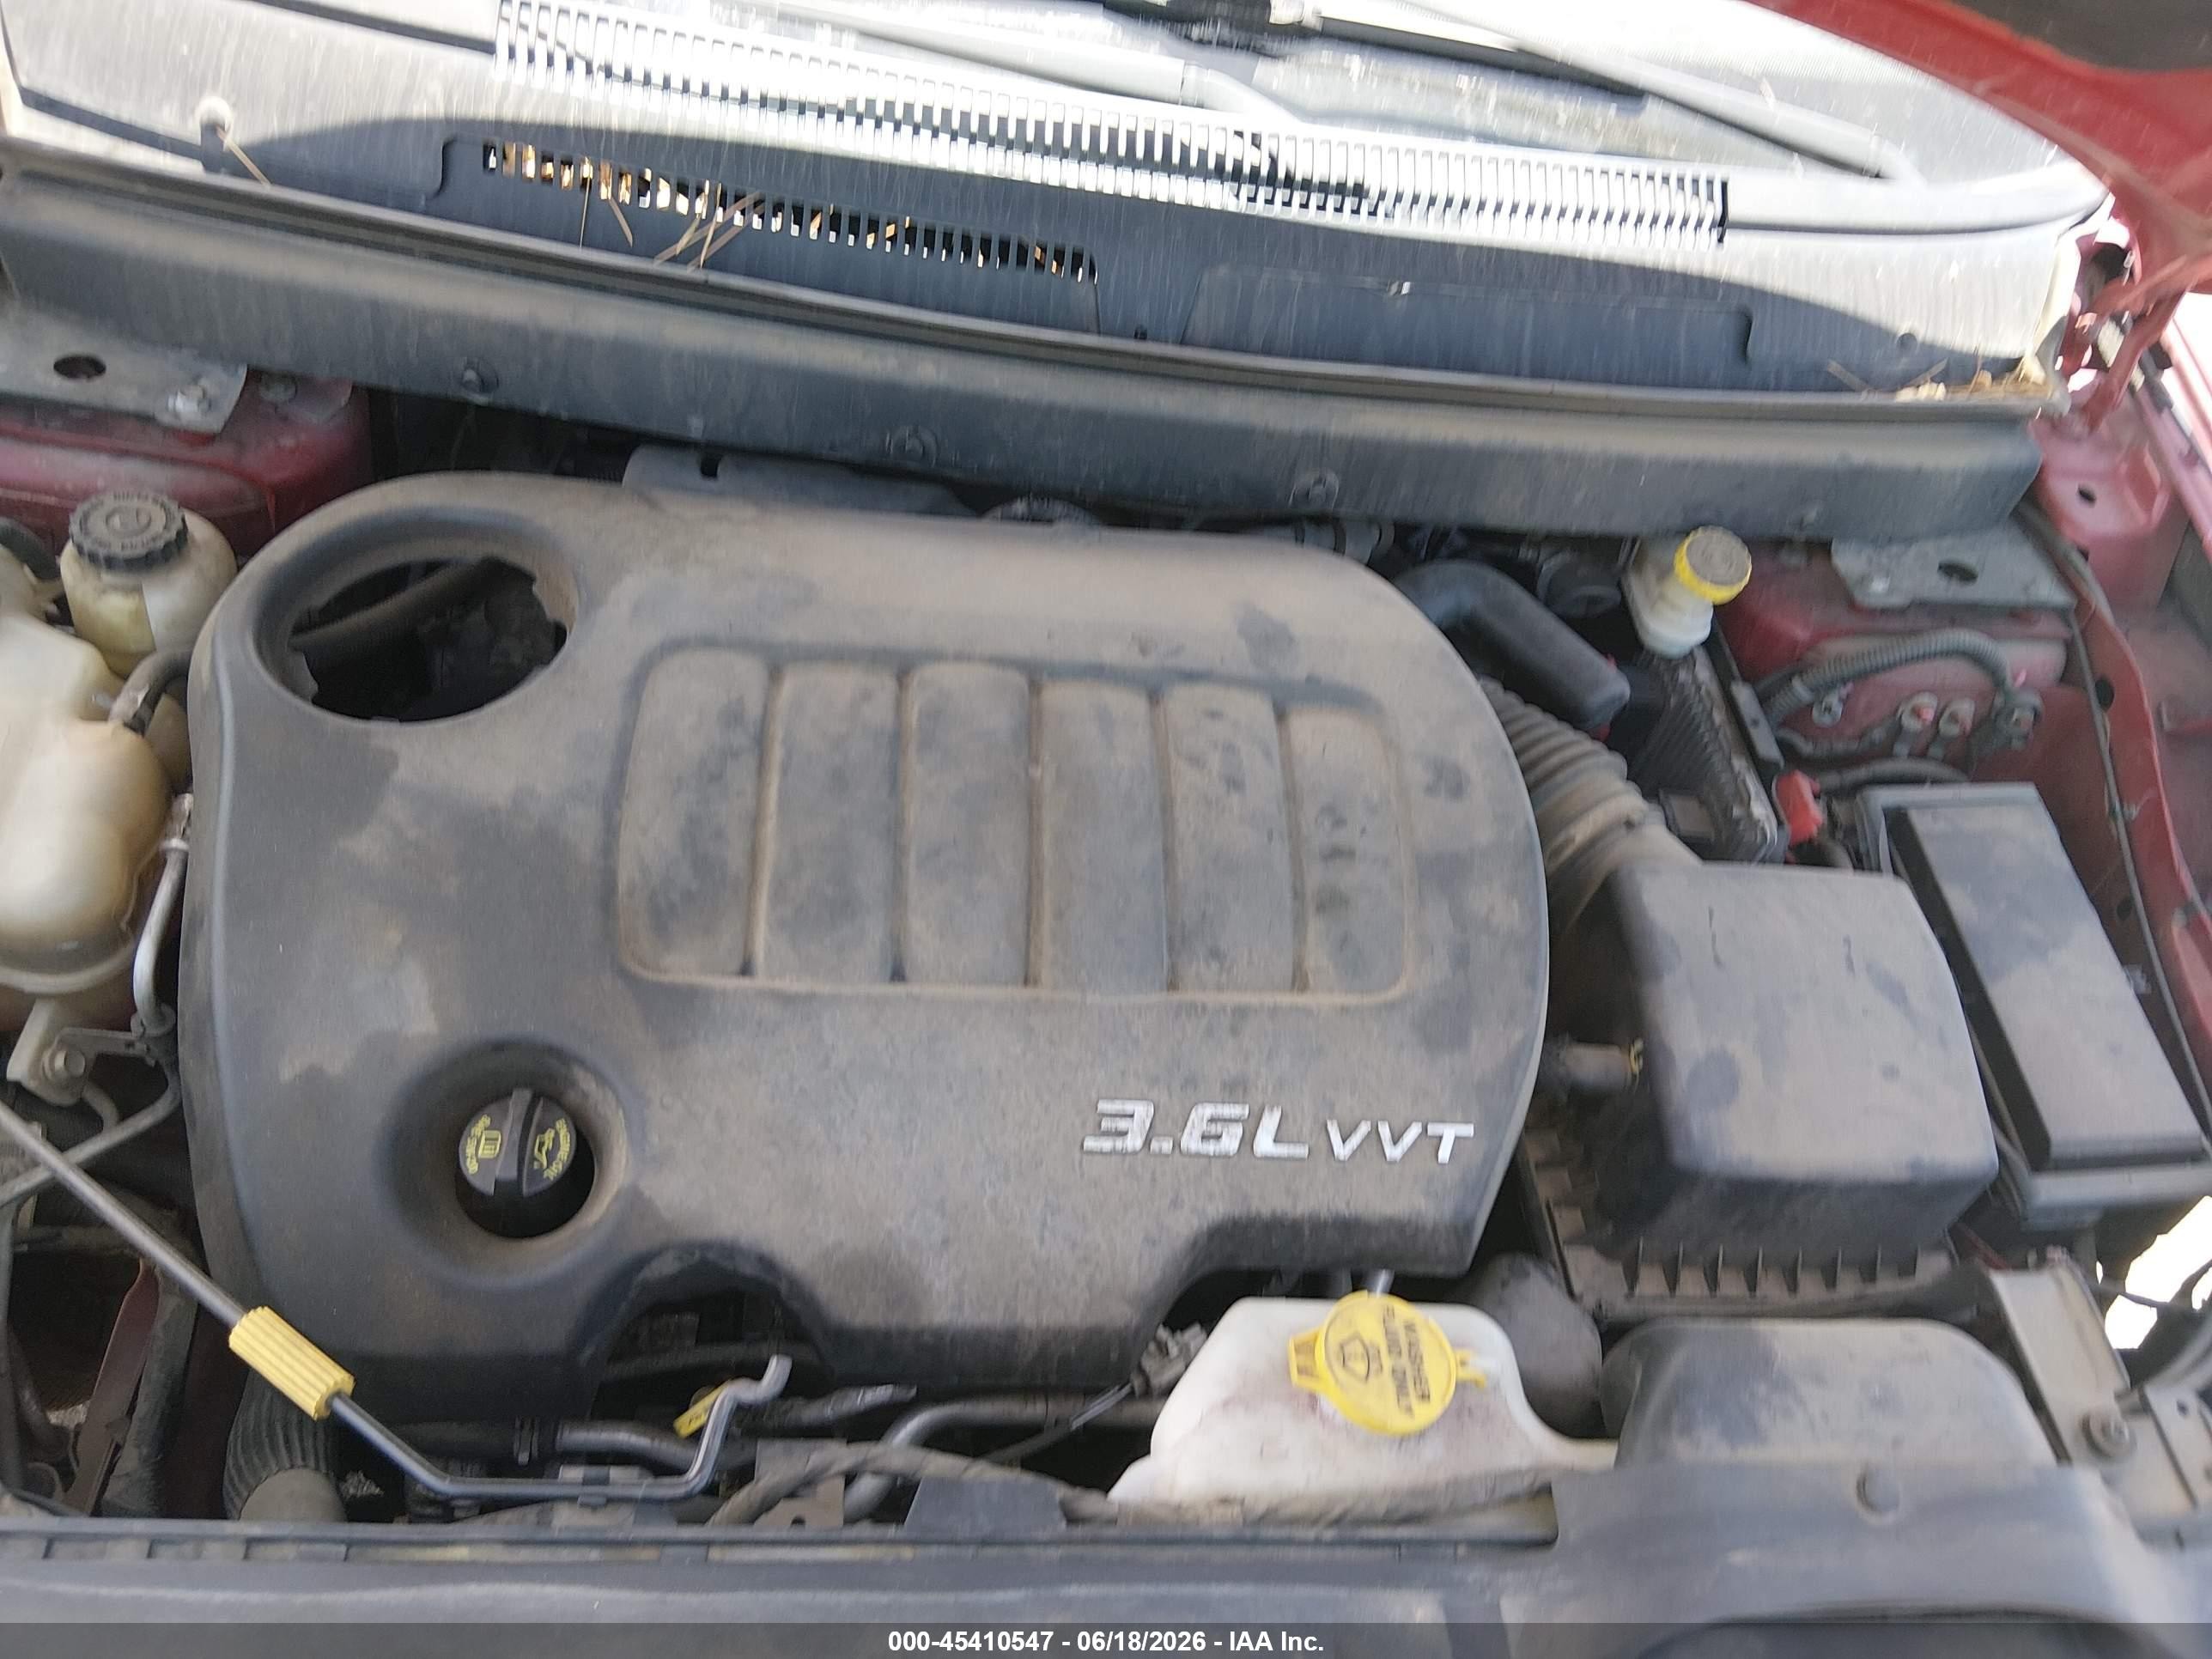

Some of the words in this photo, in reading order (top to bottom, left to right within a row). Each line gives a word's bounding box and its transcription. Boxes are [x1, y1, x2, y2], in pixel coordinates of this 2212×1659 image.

[1083, 1098, 1310, 1159] 3.6L
[1327, 1118, 1474, 1164] VVT
[1381, 1304, 1402, 1358] FLUID
[1390, 1363, 1415, 1419] ONLY
[1403, 1321, 1431, 1403] WASHER
